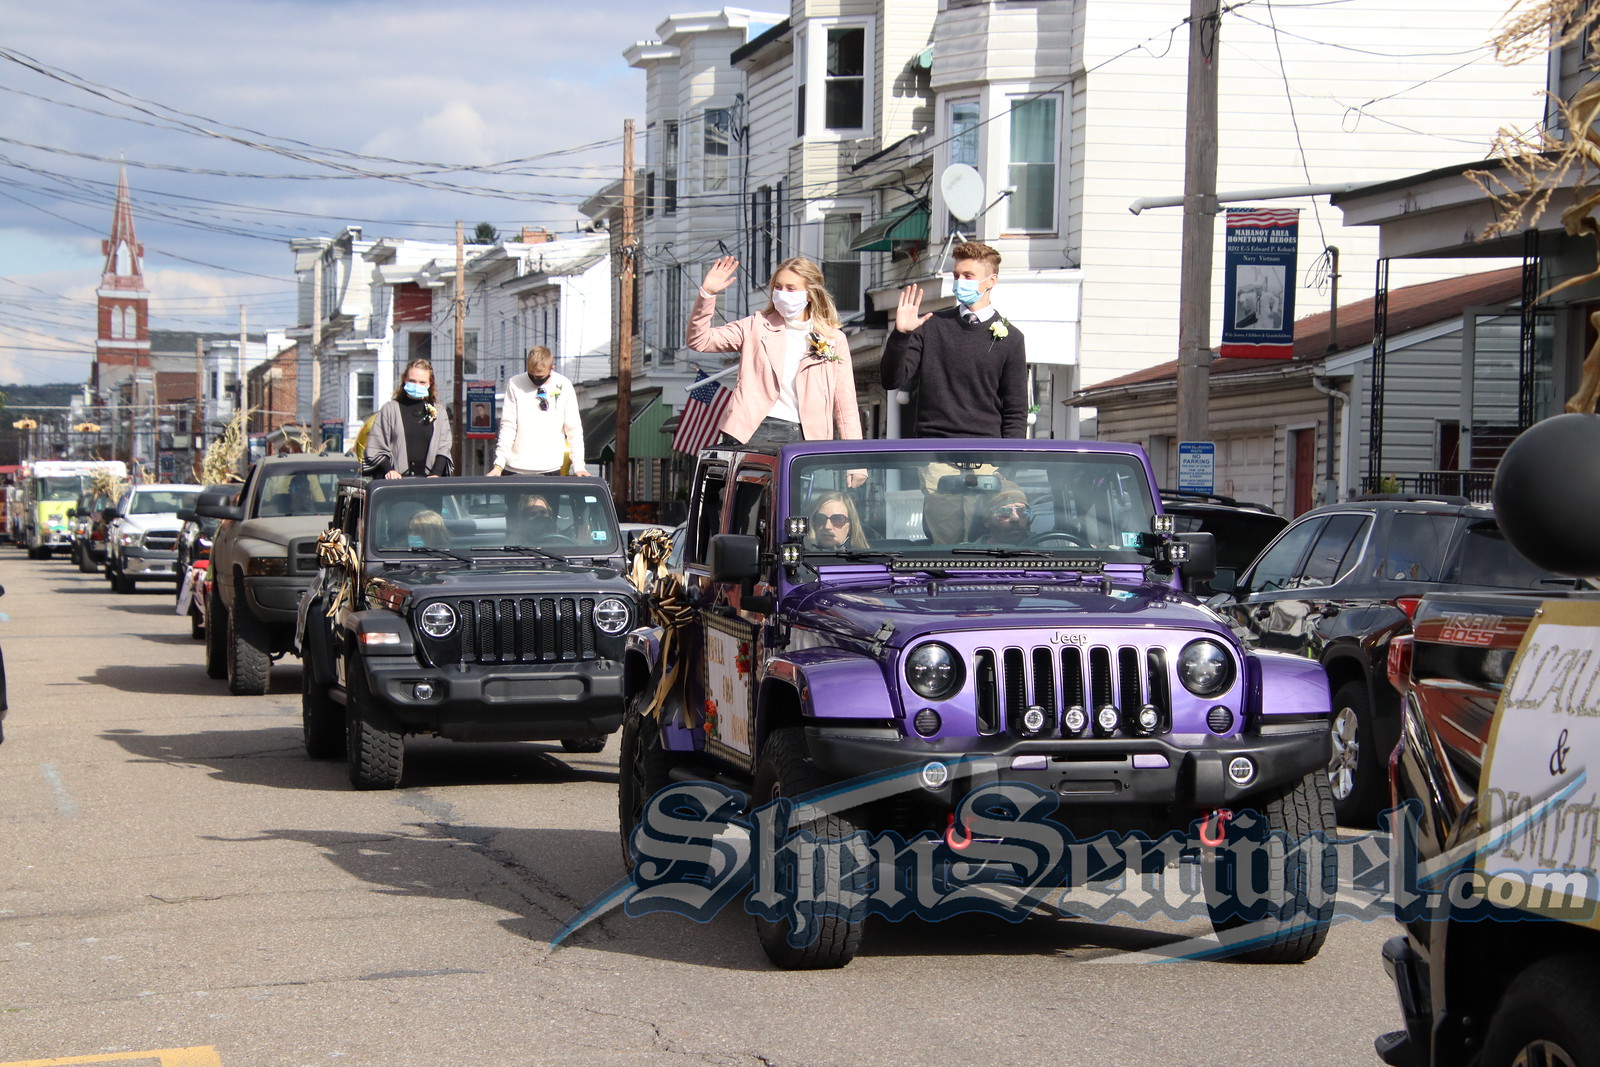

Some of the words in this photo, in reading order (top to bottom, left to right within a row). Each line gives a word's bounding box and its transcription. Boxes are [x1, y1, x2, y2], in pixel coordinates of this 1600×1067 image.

[1235, 229, 1269, 237] MAHANOY
[1270, 229, 1289, 237] AREA
[1269, 236, 1297, 244] HEROES
[1441, 611, 1507, 632] TRAIL
[1050, 631, 1089, 646] Jeep
[1439, 628, 1495, 645] BOSS
[1550, 729, 1570, 775] &
